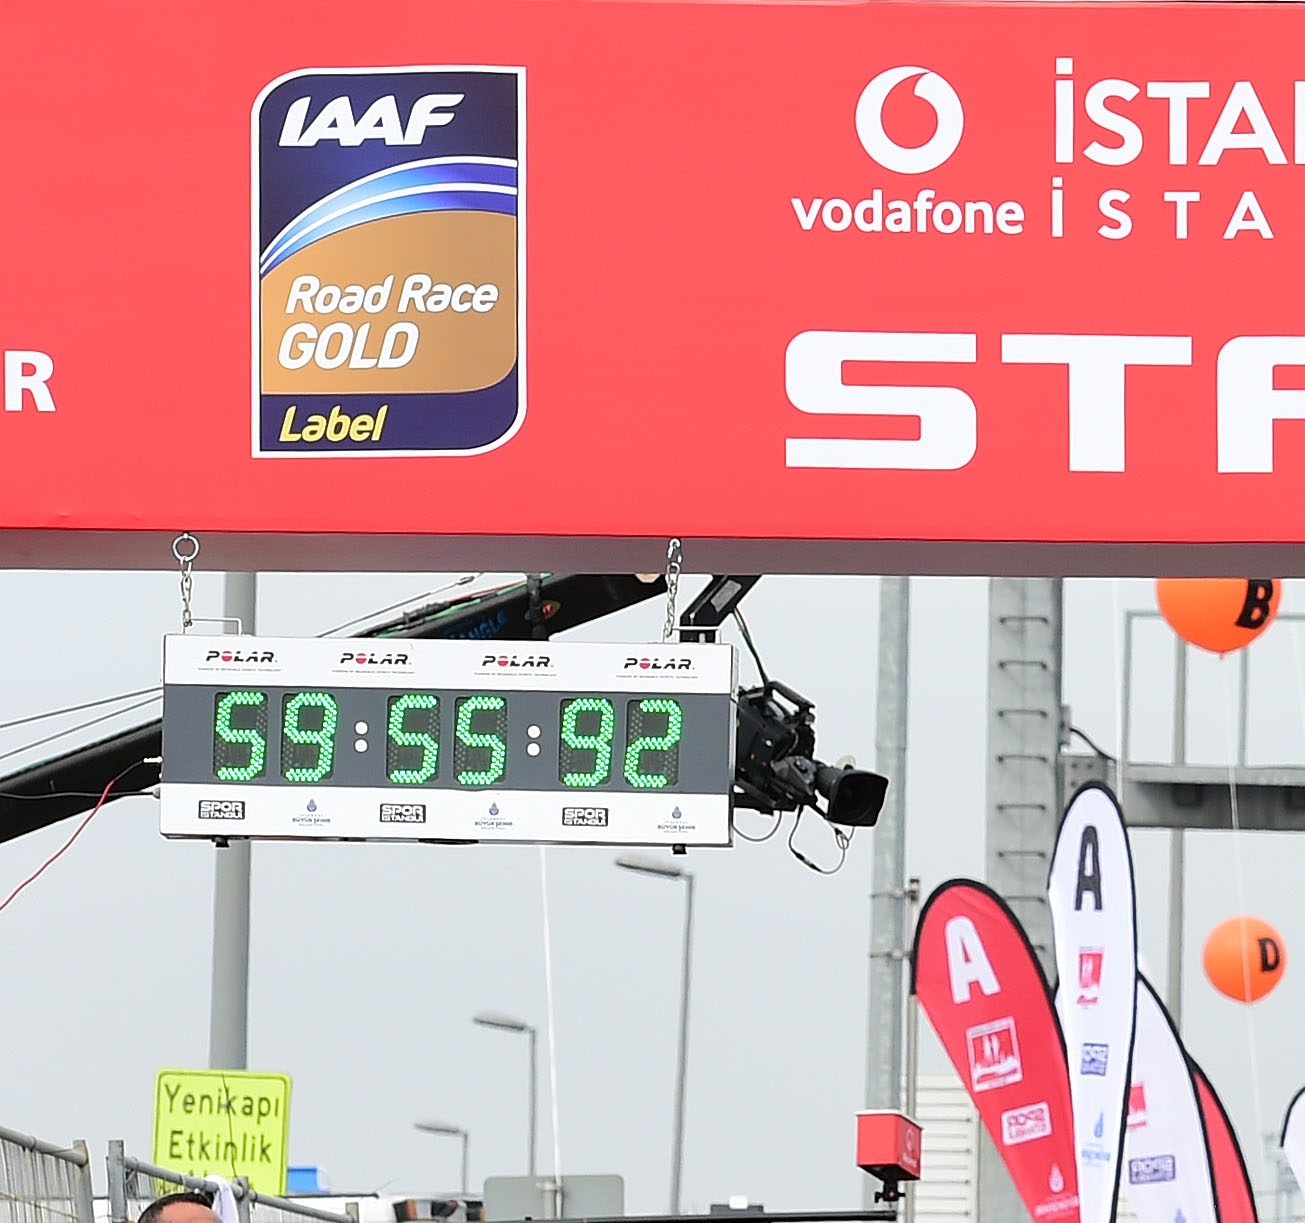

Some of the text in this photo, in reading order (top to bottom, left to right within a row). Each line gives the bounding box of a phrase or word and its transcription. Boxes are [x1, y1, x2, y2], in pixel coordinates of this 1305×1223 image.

[278, 93, 465, 147] IAAF
[791, 189, 1024, 235] vodafone
[284, 274, 500, 314] Road Race
[278, 322, 420, 372] GOLD
[278, 404, 387, 444] Label
[1235, 578, 1274, 630] B
[205, 650, 276, 664] POLAR
[340, 652, 409, 666] POLAR
[481, 655, 551, 668] POLAR
[623, 657, 693, 670] POLAR
[1074, 825, 1105, 912] A
[944, 916, 1001, 1004] A
[1256, 936, 1281, 973] D
[164, 1083, 279, 1125] Yenikapı
[169, 1130, 272, 1164] Etkinlik
